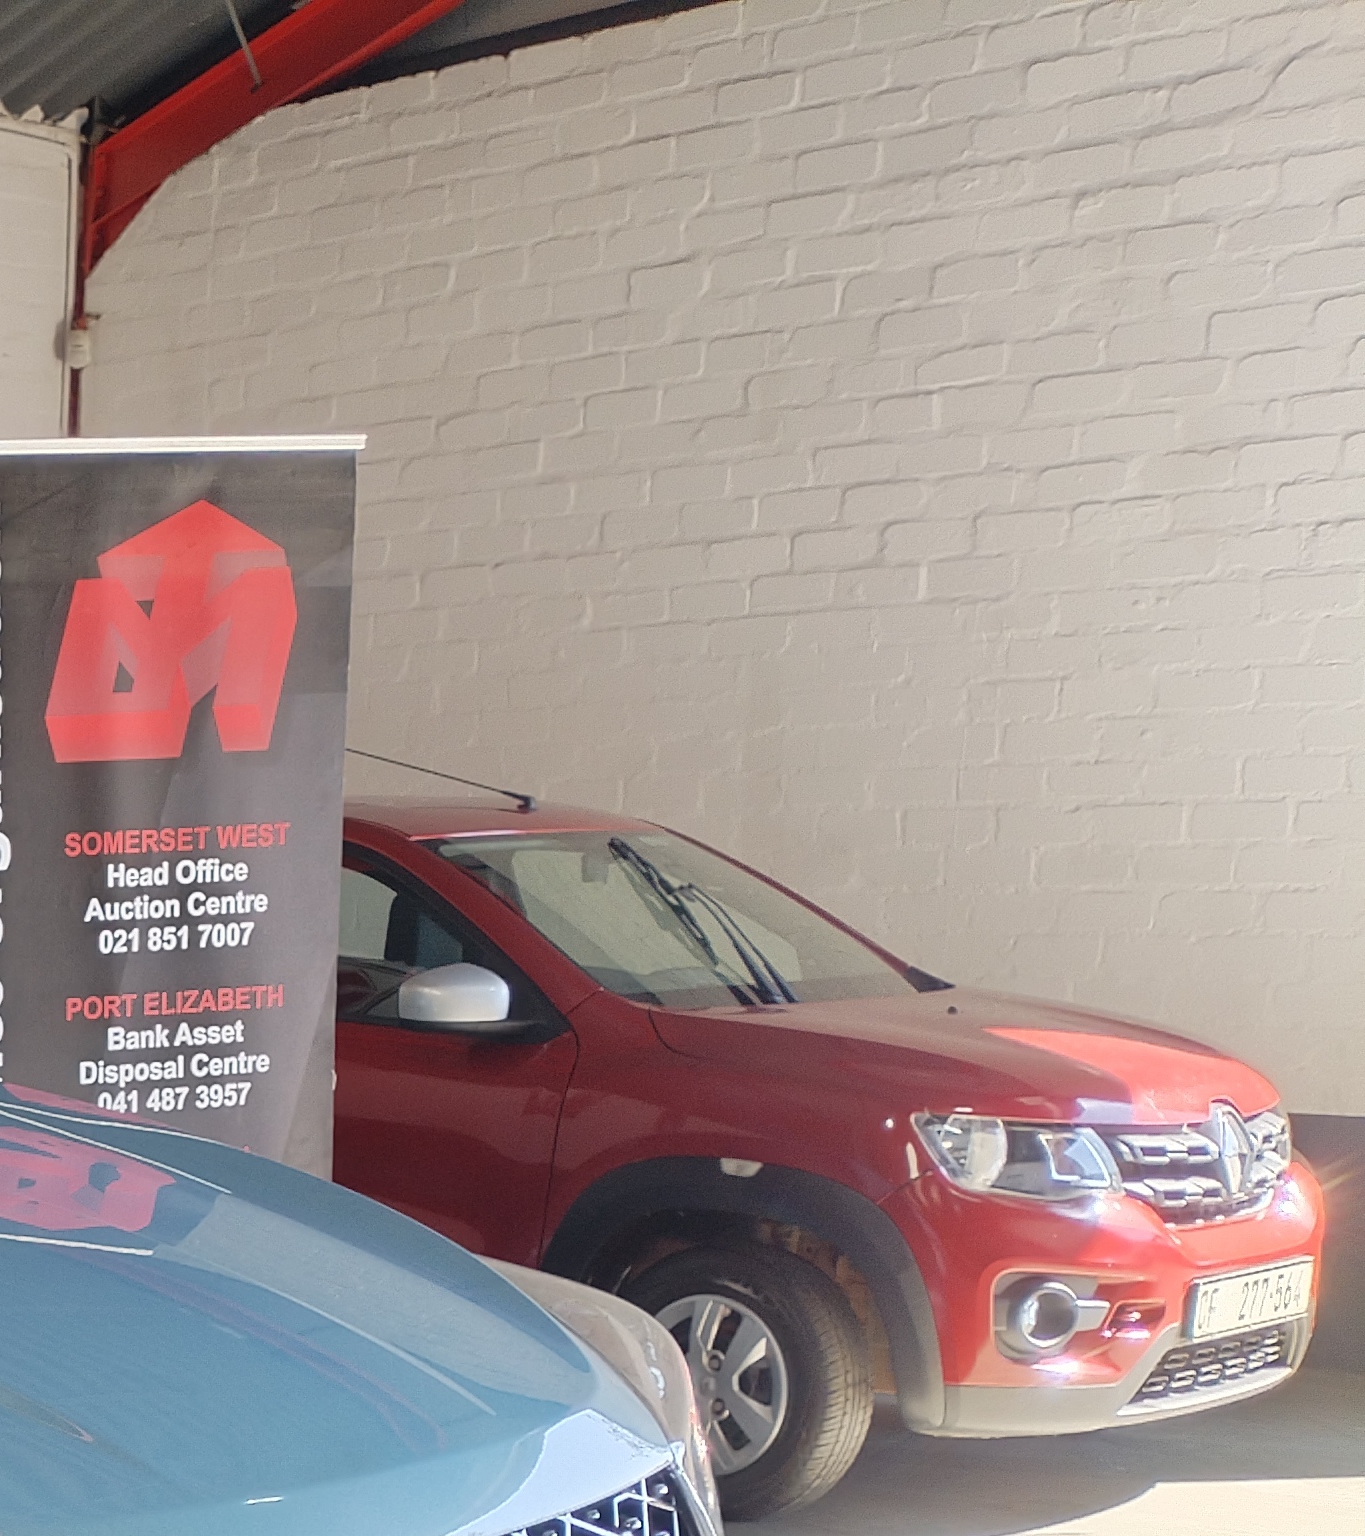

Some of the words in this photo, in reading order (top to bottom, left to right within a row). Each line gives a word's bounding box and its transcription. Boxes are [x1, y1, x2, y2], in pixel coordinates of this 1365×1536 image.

[64, 826, 211, 858] SOMERSET
[216, 822, 291, 849] WEST
[107, 861, 169, 888] Head
[175, 858, 249, 885] Office
[84, 894, 180, 922] Auction
[187, 890, 269, 917] Centre
[98, 928, 139, 955] 021
[147, 925, 189, 952] 851
[197, 922, 255, 949] 7007
[65, 994, 137, 1021] PORT
[143, 984, 284, 1016] ELIZABETH
[107, 1024, 169, 1051] Bank
[174, 1020, 245, 1047] Asset
[79, 1055, 184, 1088] Disposal
[191, 1051, 270, 1078] Centre
[146, 1087, 190, 1112] 487
[195, 1082, 252, 1109] 3957
